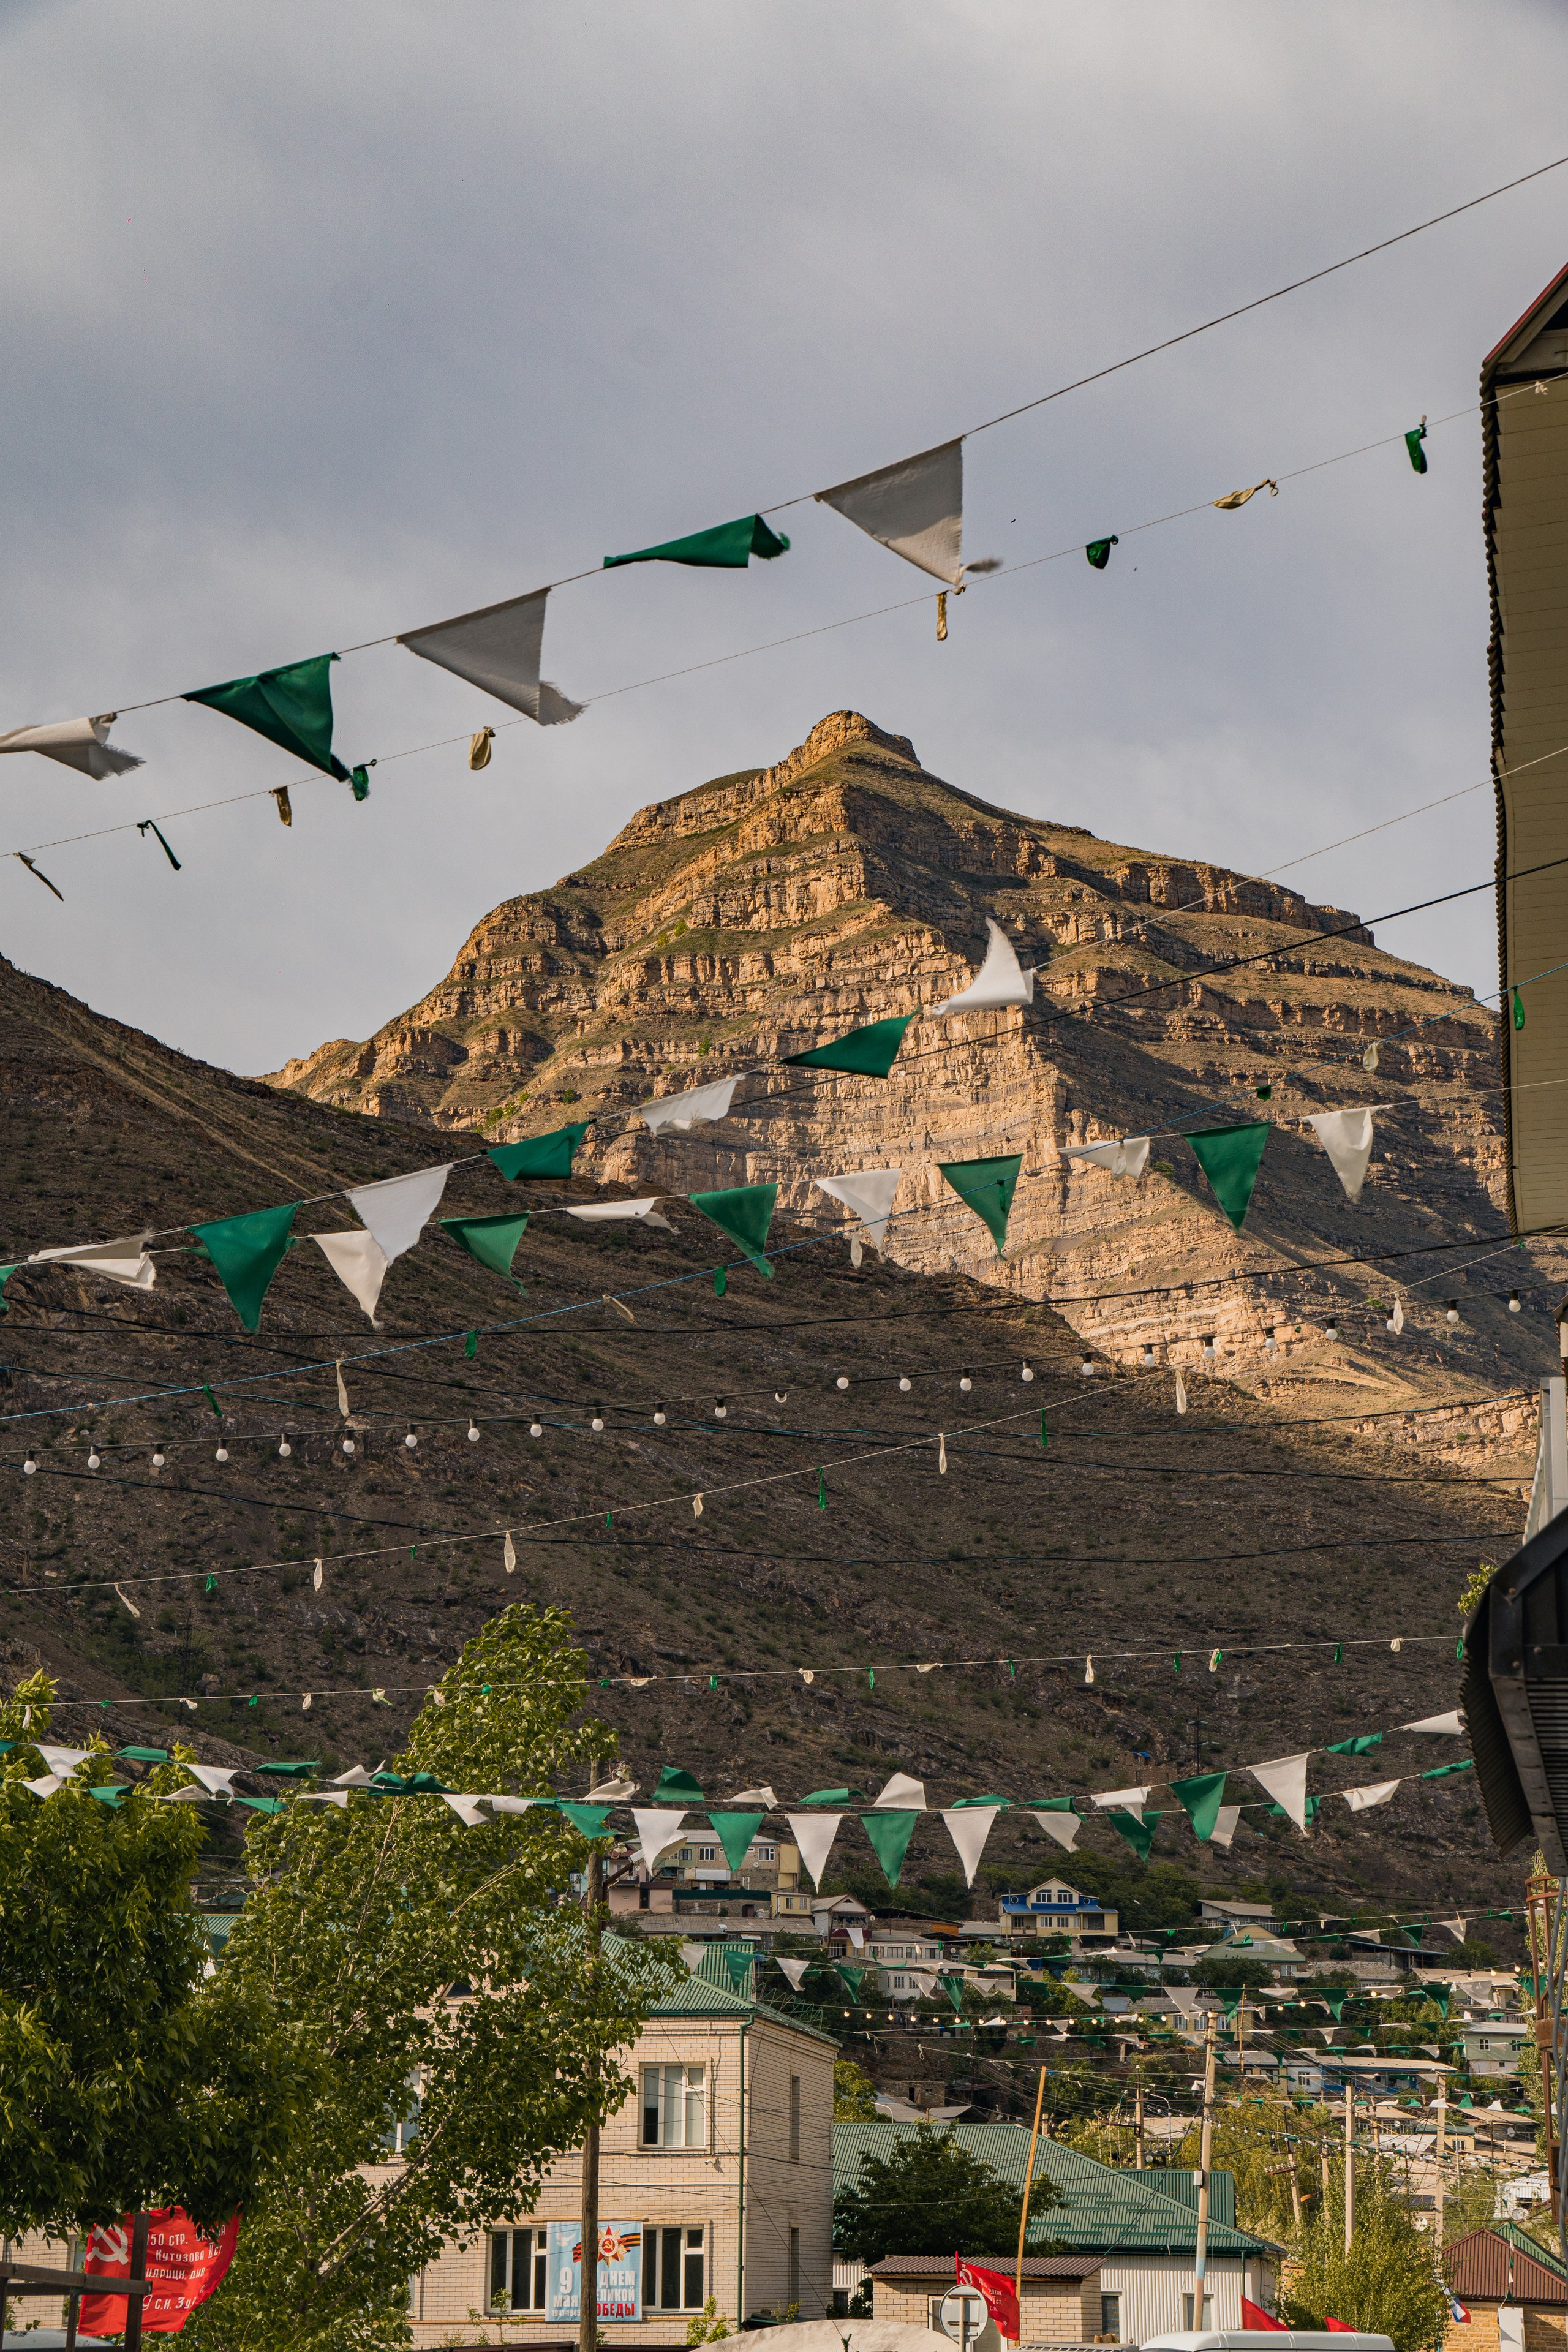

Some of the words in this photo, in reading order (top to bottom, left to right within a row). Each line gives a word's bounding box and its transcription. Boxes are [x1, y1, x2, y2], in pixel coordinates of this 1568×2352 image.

[168, 2233, 188, 2246] СТР.
[559, 2266, 573, 2294] 9
[599, 2270, 635, 2288] ДНЕМ
[553, 2294, 578, 2307] мая
[597, 2286, 635, 2301] ЕЛИКОЙ
[551, 2309, 581, 2317] 1941-1945
[597, 2302, 635, 2318] ОБЕДЫ
